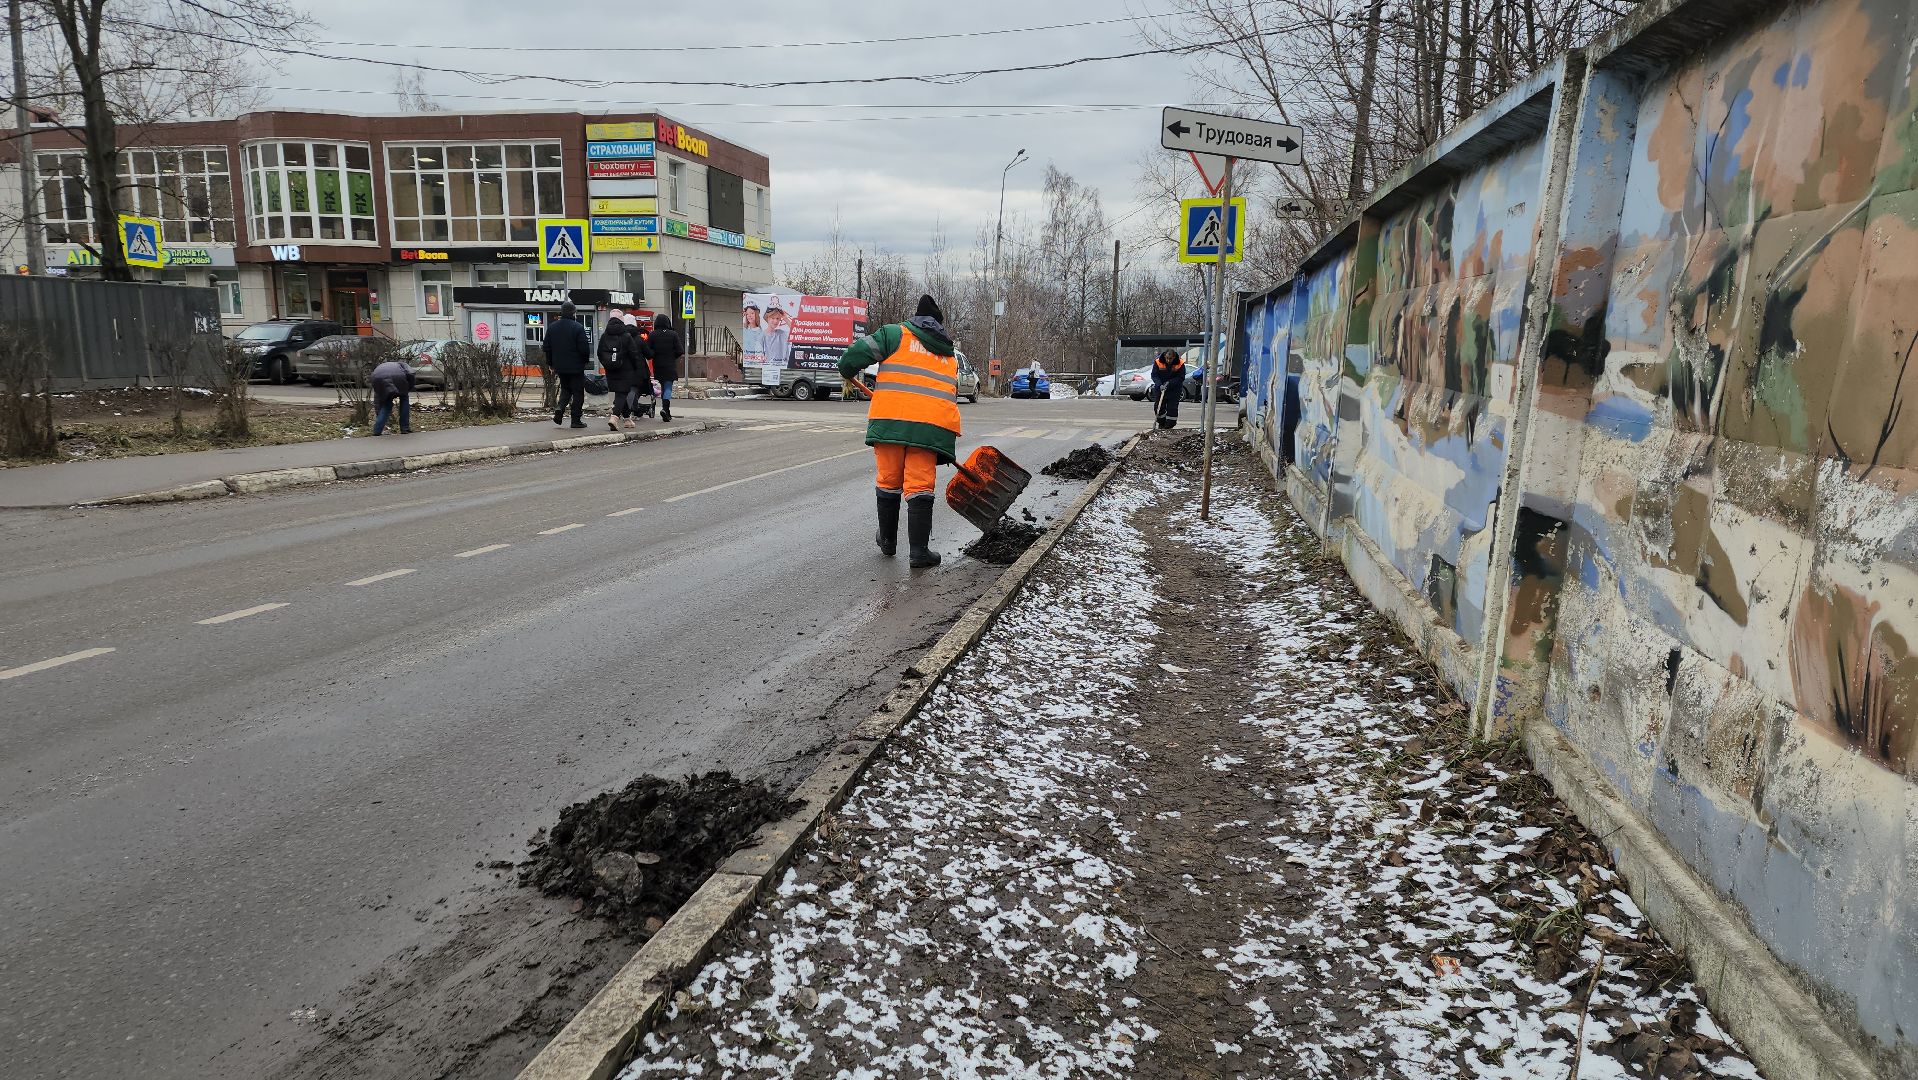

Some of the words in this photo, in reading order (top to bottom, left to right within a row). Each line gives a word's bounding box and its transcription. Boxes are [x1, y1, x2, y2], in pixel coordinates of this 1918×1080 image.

[657, 117, 708, 158] BetBoom
[1195, 122, 1272, 148] Трудовая
[590, 144, 652, 155] СТРАХОВАНИЕ
[324, 190, 337, 212] FIX
[354, 192, 367, 213] FIX
[597, 237, 642, 248] ЦВЕТЫ
[172, 249, 207, 257] ПЛАНЕТА
[270, 245, 301, 261] WB
[400, 249, 449, 260] BetBoom
[172, 257, 210, 265] ЗДОРОВЬЯ
[801, 304, 850, 315] WARPOINT
